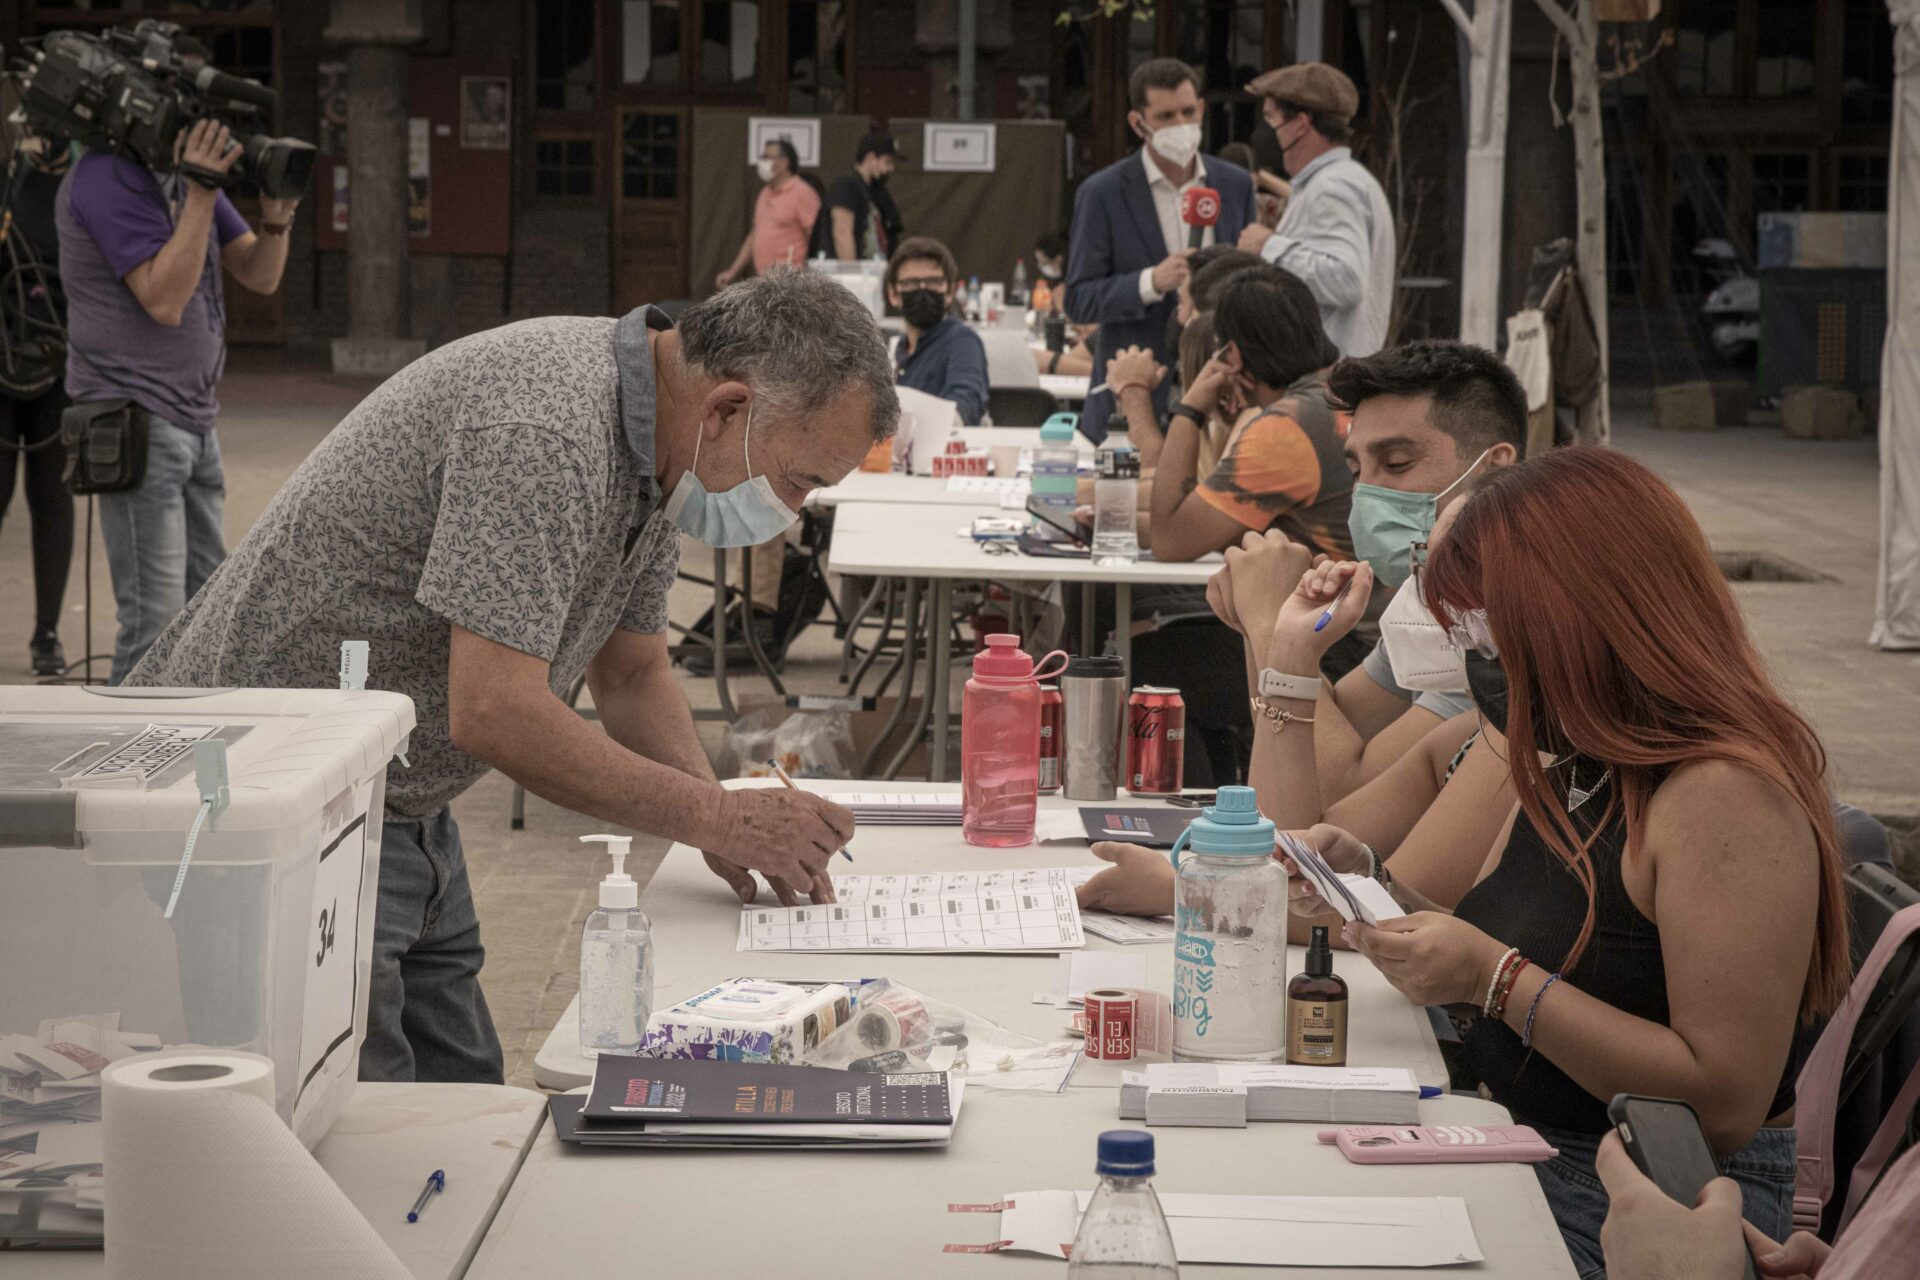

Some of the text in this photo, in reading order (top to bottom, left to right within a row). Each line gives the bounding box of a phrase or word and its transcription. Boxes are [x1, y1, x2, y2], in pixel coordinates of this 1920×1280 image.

[316, 897, 337, 968] 34
[1107, 1021, 1130, 1037] VEL
[1107, 1038, 1130, 1054] SER
